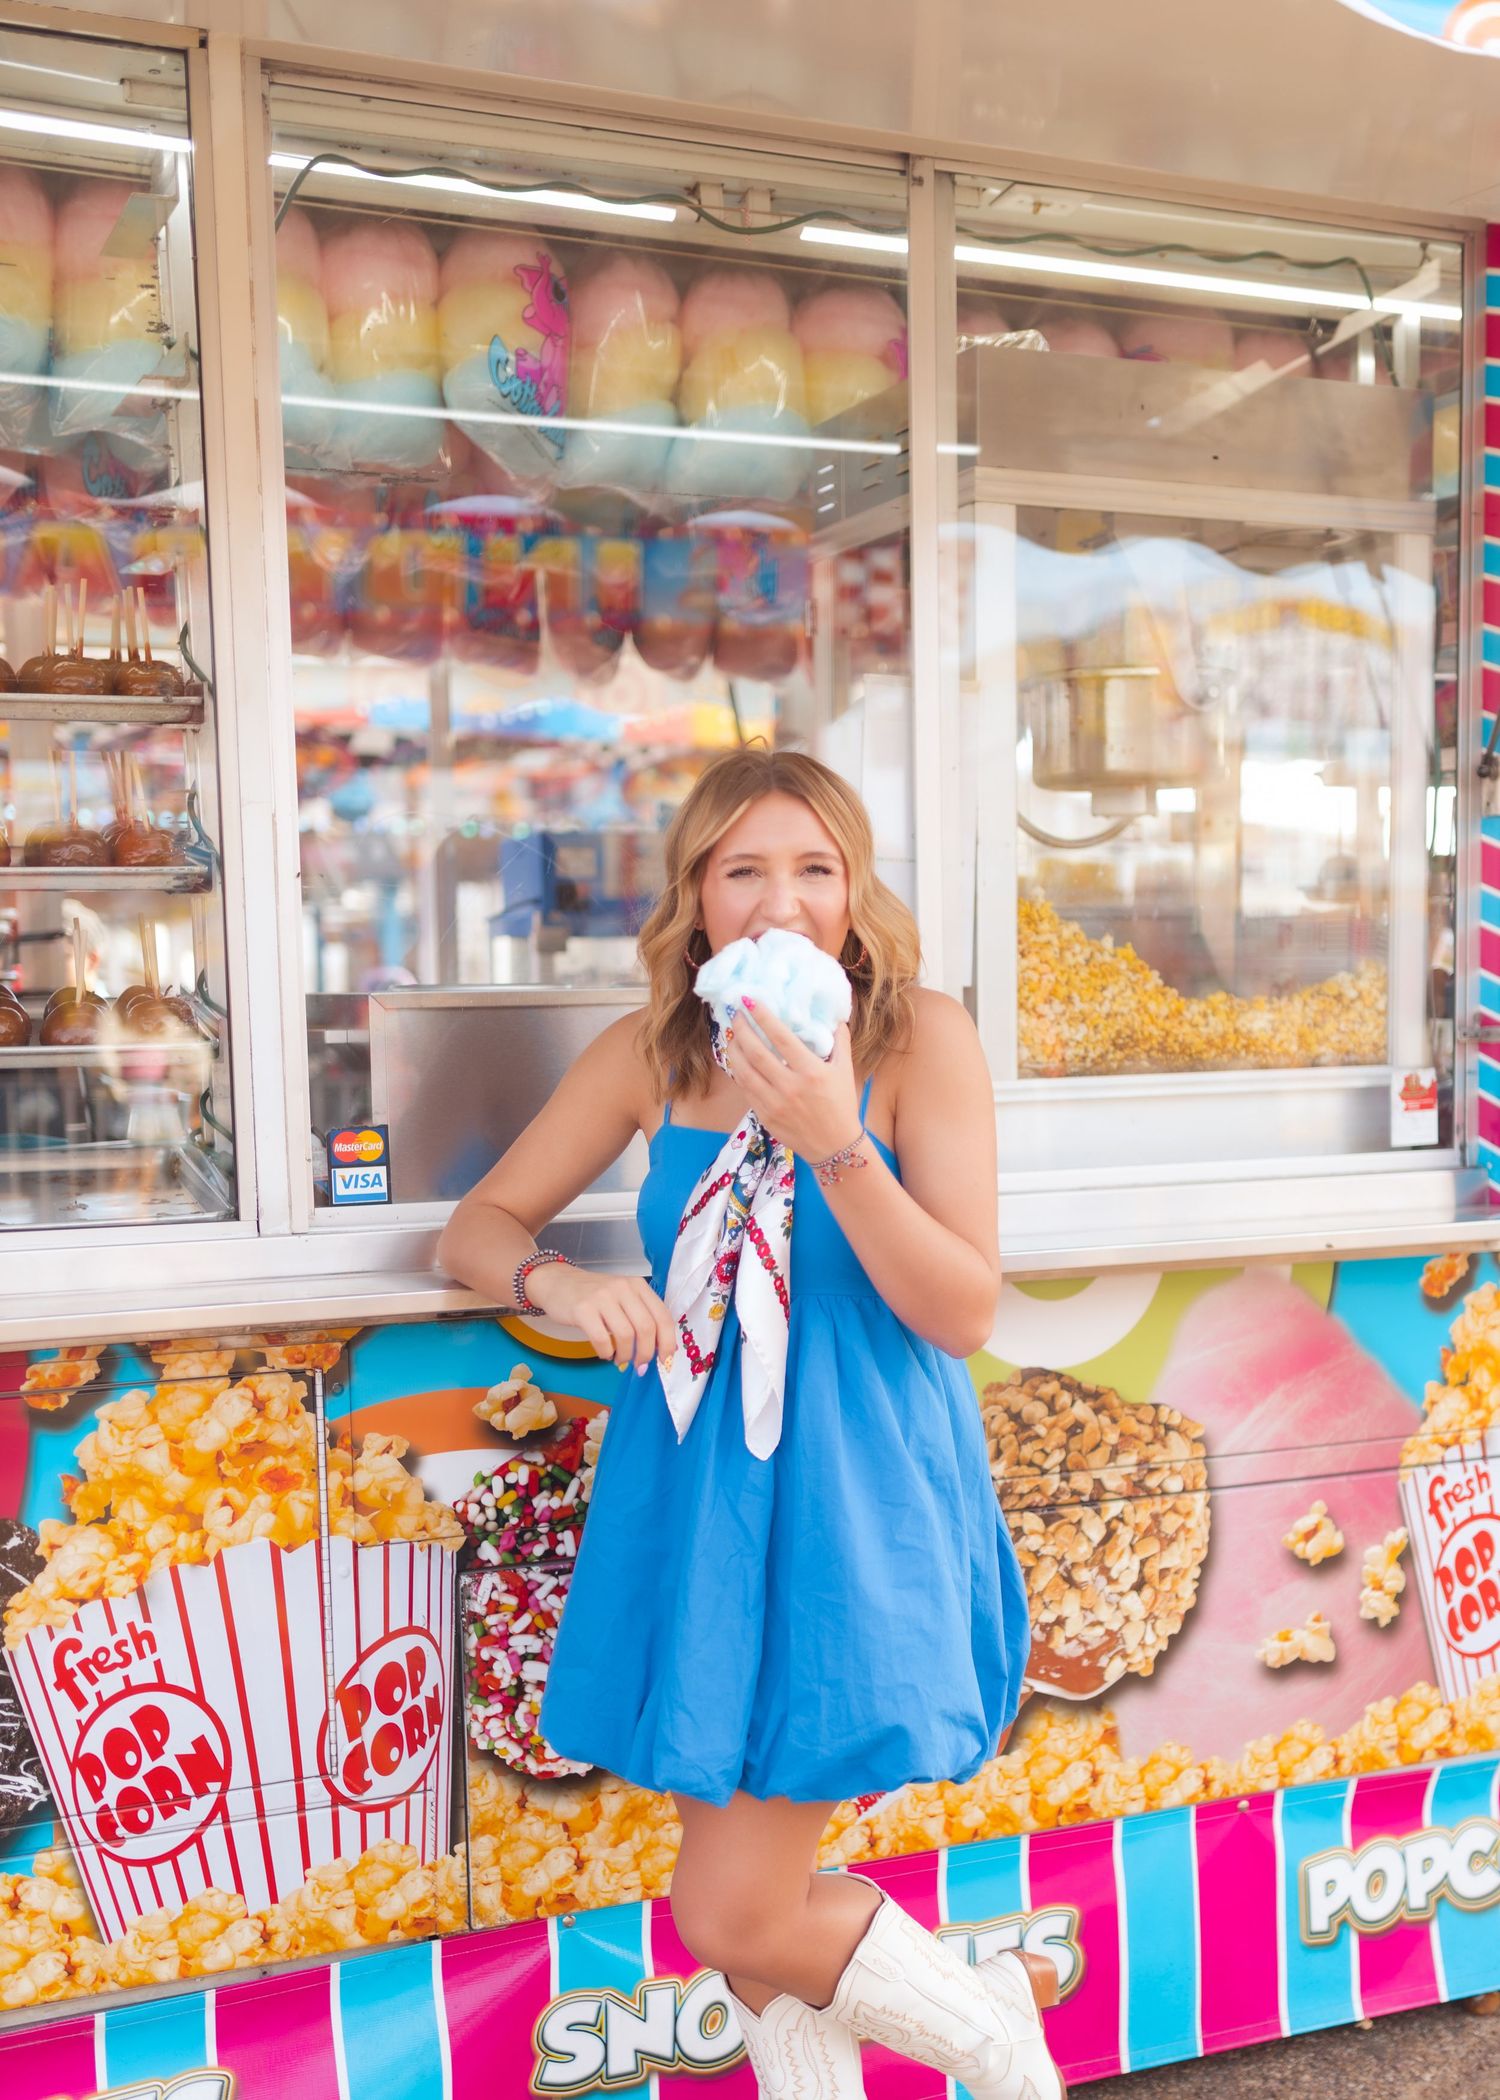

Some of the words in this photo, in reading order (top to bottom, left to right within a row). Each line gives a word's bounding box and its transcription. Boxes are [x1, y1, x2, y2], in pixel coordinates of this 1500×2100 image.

[334, 1141, 383, 1153] MasterCard
[338, 1173, 383, 1190] VISA
[1429, 1465, 1491, 1531] fresh
[1435, 1530, 1495, 1604] POP
[1447, 1571, 1500, 1642] COR
[53, 1620, 158, 1712] fresh
[337, 1646, 427, 1743] POP
[76, 1704, 170, 1804] POP
[342, 1683, 442, 1795] CORN
[96, 1734, 225, 1848] CORN
[1302, 1821, 1500, 1939] POPC
